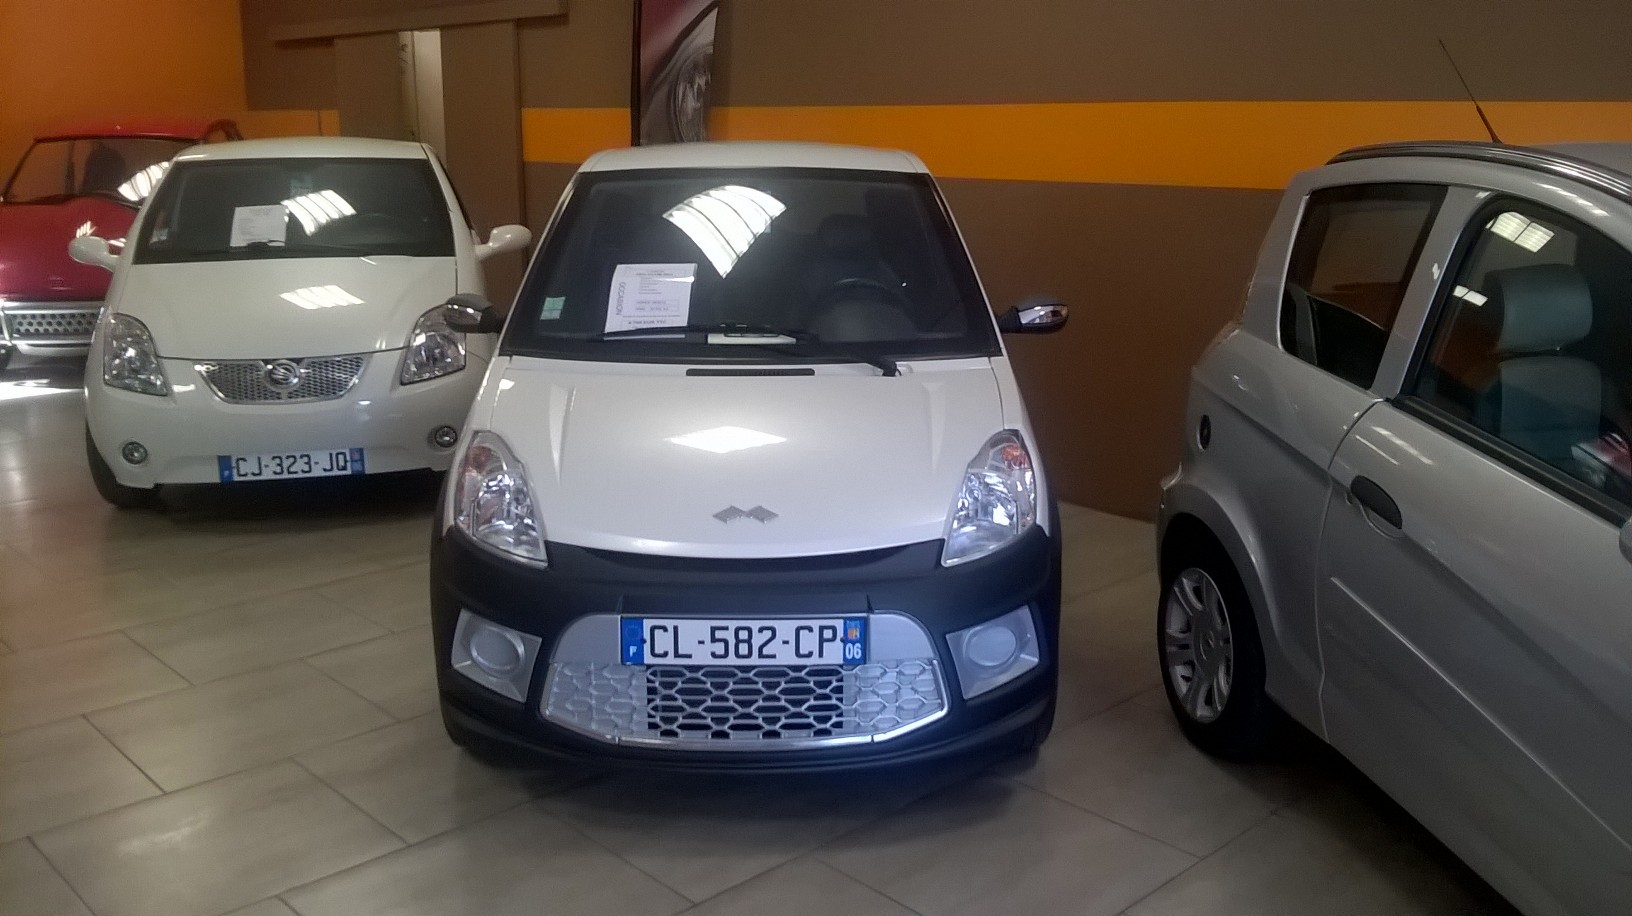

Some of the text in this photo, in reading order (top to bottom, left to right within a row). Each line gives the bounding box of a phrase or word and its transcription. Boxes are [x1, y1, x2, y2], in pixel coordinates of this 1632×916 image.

[615, 281, 626, 315] OCCASION
[234, 451, 348, 477] CJ-323-JQ
[629, 624, 862, 659] F CL-582-CP 06
